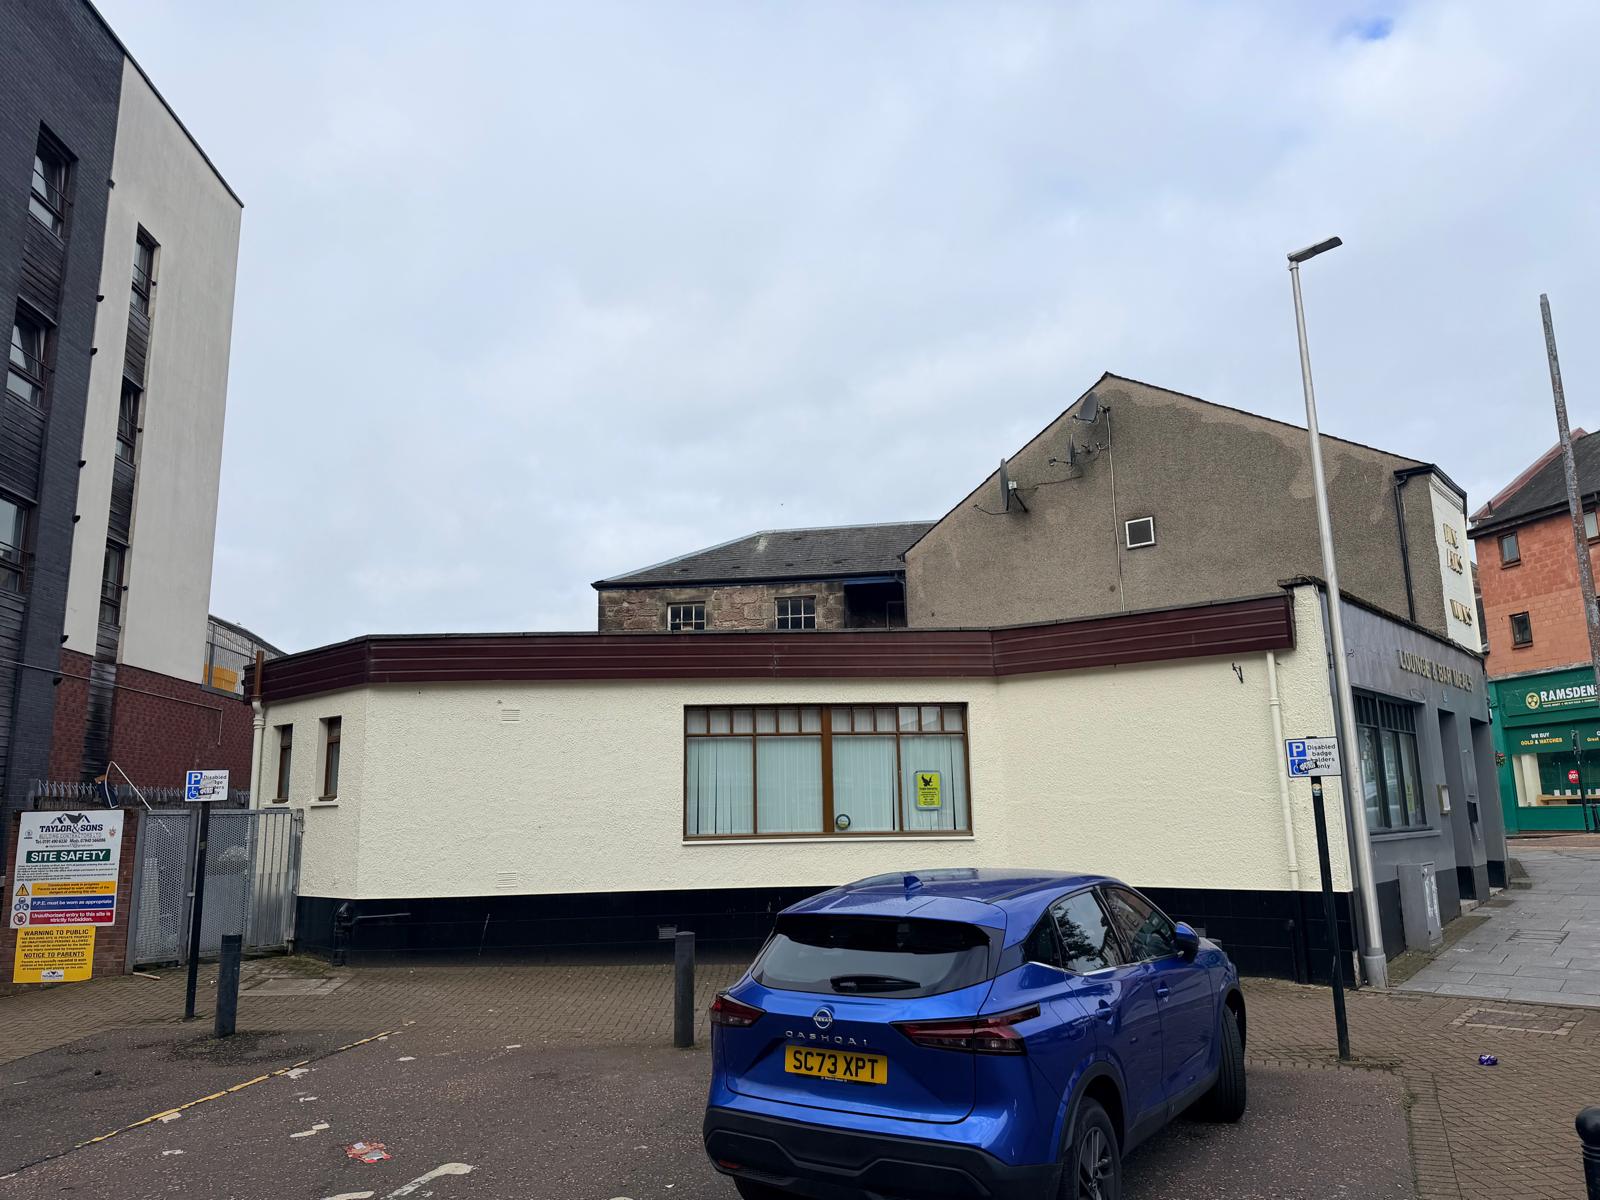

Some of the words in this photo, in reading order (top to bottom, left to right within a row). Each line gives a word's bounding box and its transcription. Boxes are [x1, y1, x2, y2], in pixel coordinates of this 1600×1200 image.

[1400, 649, 1432, 678] LOUNGE
[1438, 664, 1452, 685] BAR
[1453, 668, 1472, 692] MEALS
[31, 852, 57, 862] SITE
[60, 851, 106, 860] SAFETY
[786, 1031, 867, 1045] QASHQAI
[793, 1050, 838, 1074] SC73
[843, 1056, 878, 1079] XPT
